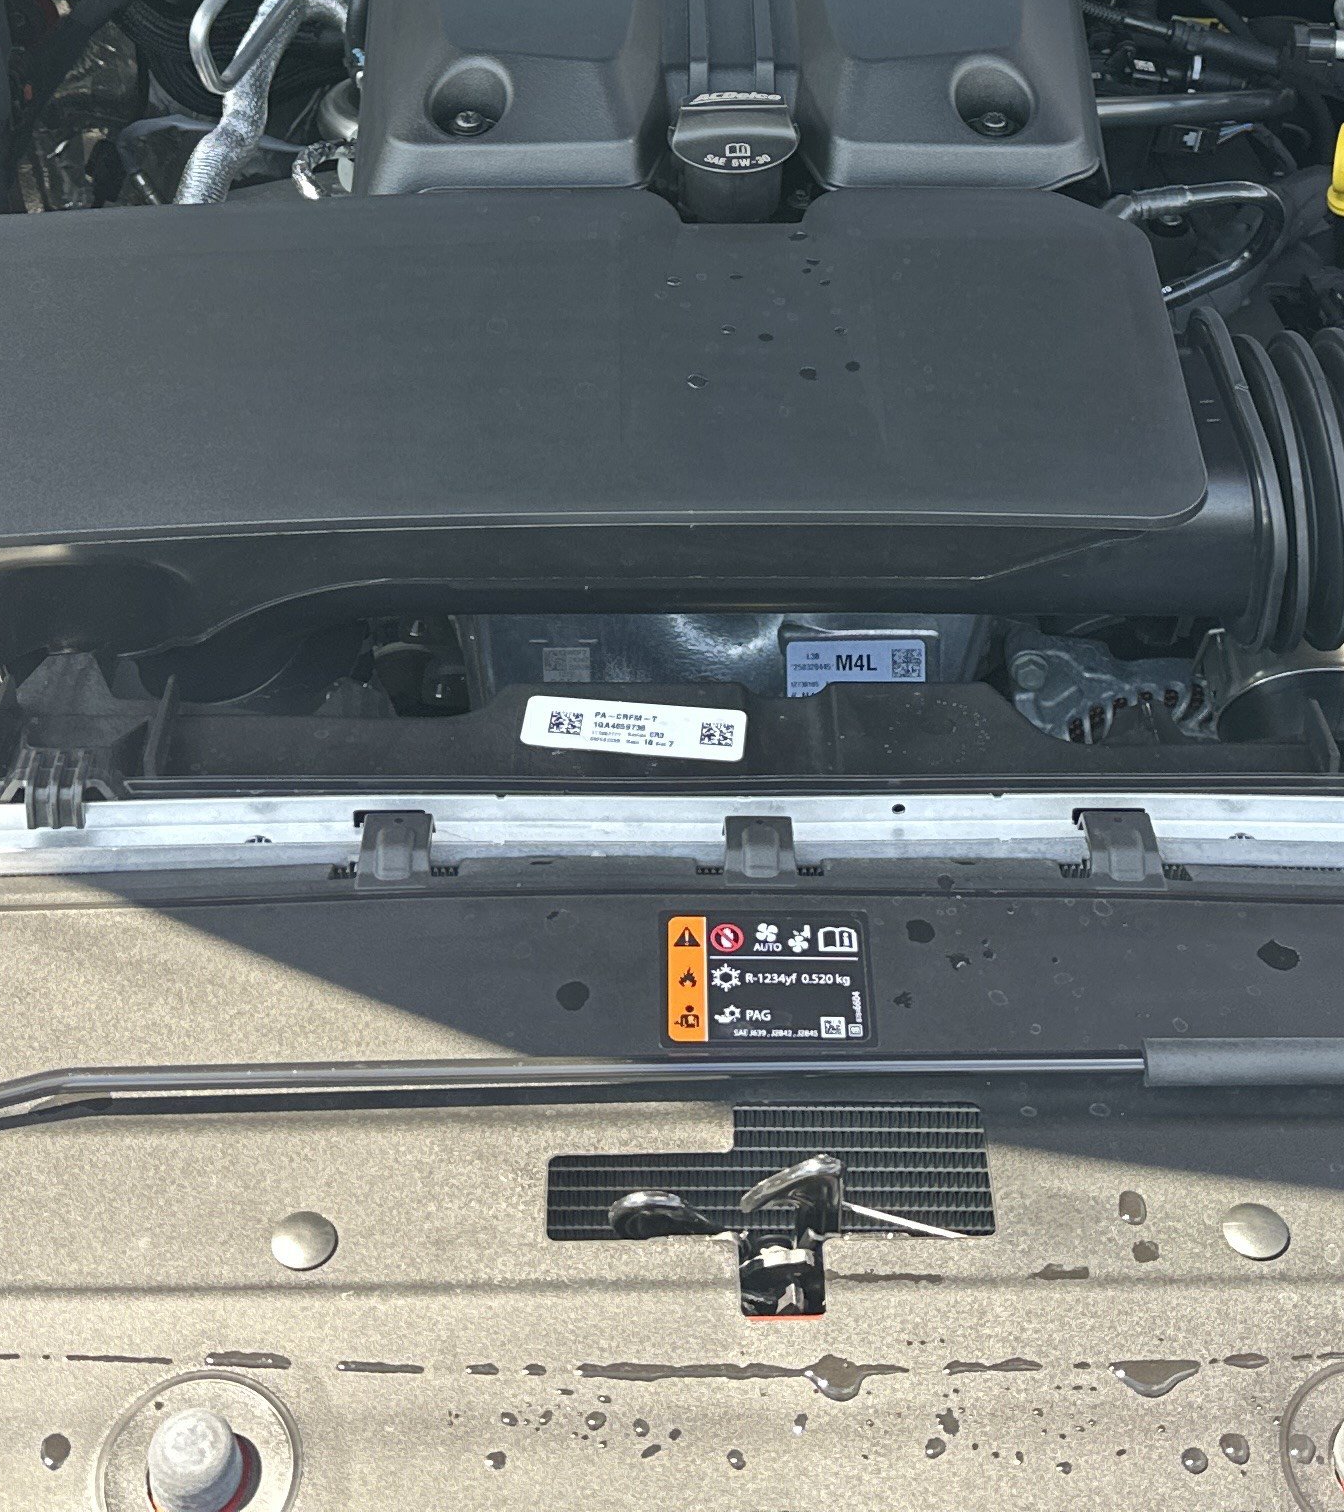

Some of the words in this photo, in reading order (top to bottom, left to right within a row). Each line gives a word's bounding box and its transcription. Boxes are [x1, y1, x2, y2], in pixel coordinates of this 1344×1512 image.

[689, 91, 782, 105] ACDelco
[704, 154, 727, 166] SAE
[731, 154, 771, 167] 5W-30
[835, 654, 878, 672] M4L
[753, 942, 783, 952] AUTO
[745, 972, 798, 986] R-1234yf
[802, 973, 834, 985] 0.520
[835, 973, 851, 986] kg
[745, 1009, 772, 1022] PAG
